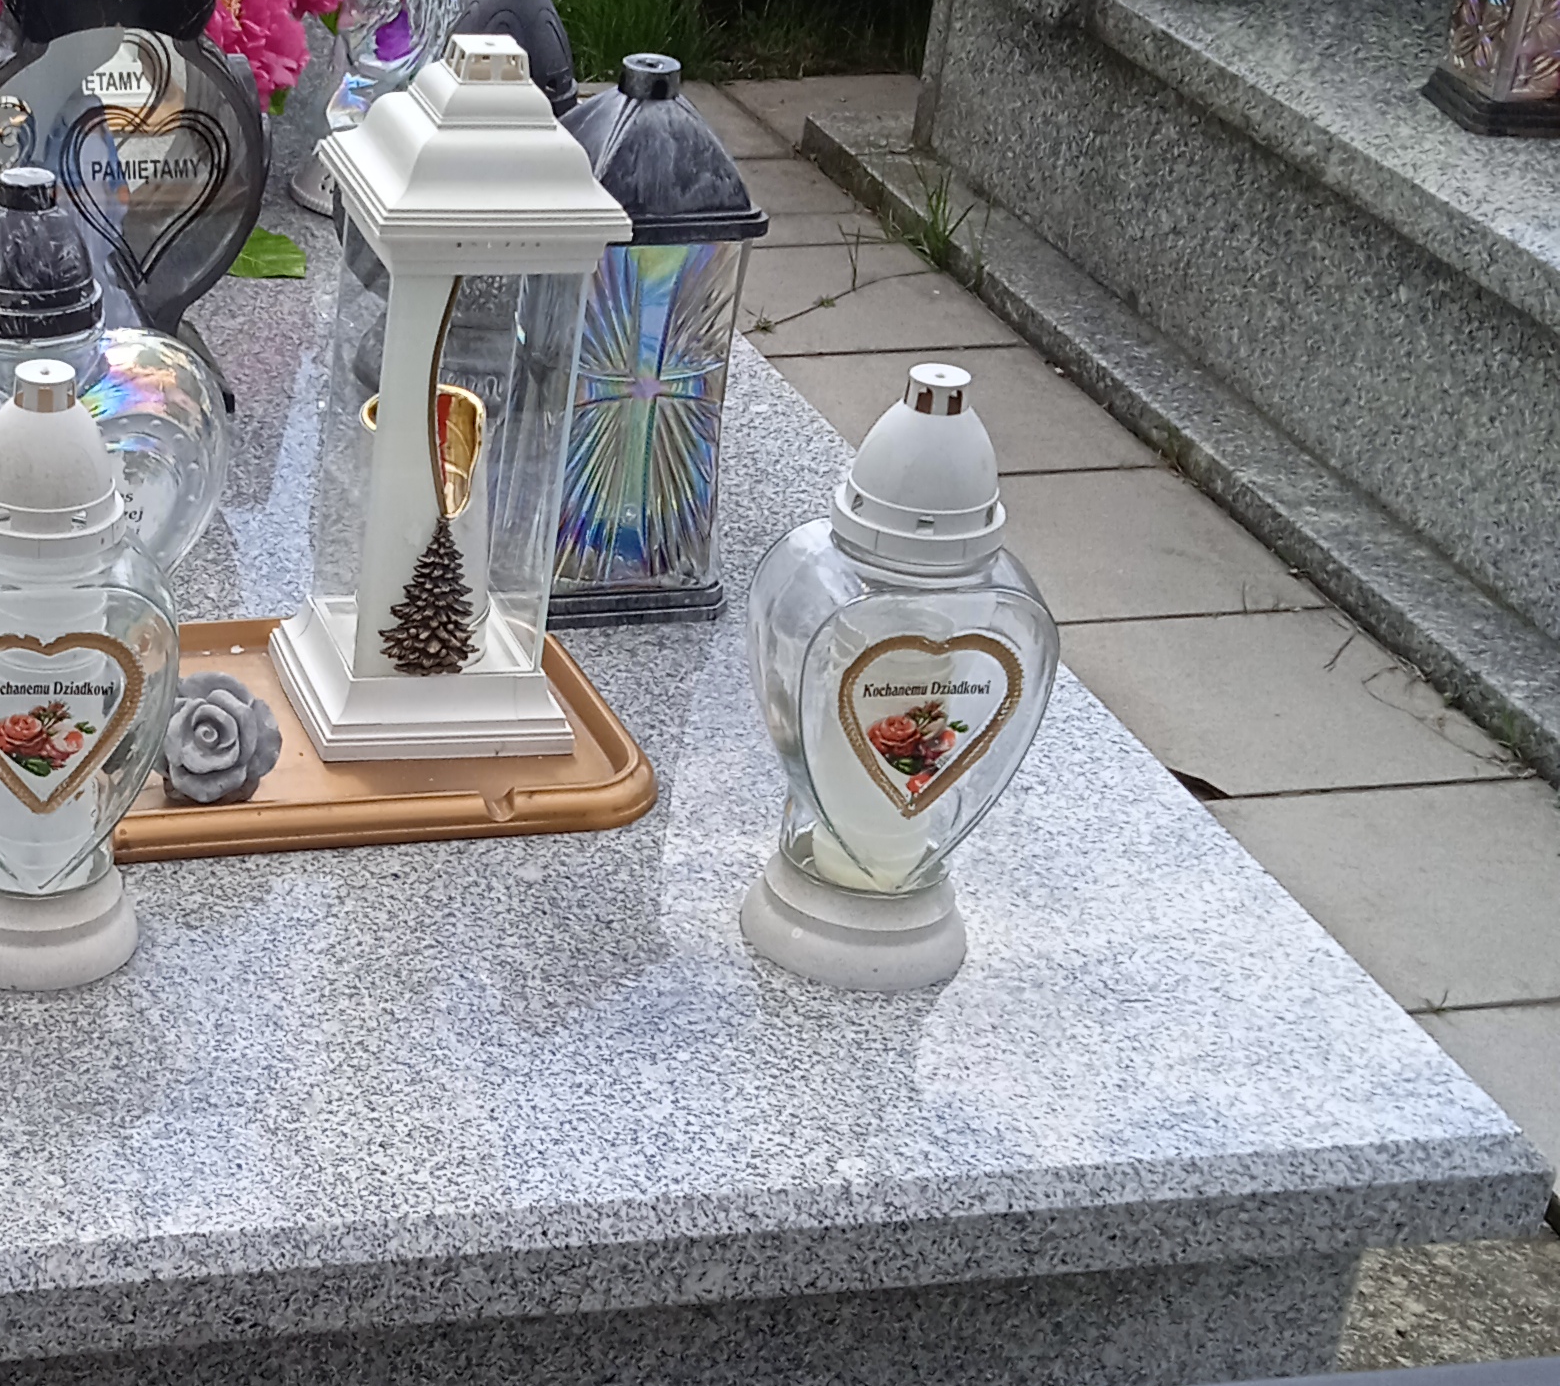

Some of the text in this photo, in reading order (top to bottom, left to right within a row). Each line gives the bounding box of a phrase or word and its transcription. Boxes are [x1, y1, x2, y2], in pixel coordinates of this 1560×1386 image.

[91, 158, 200, 184] PAMIĘTAMY
[53, 680, 115, 696] Dziadkowi
[863, 680, 992, 698] Kochanemu Dziadkowi
